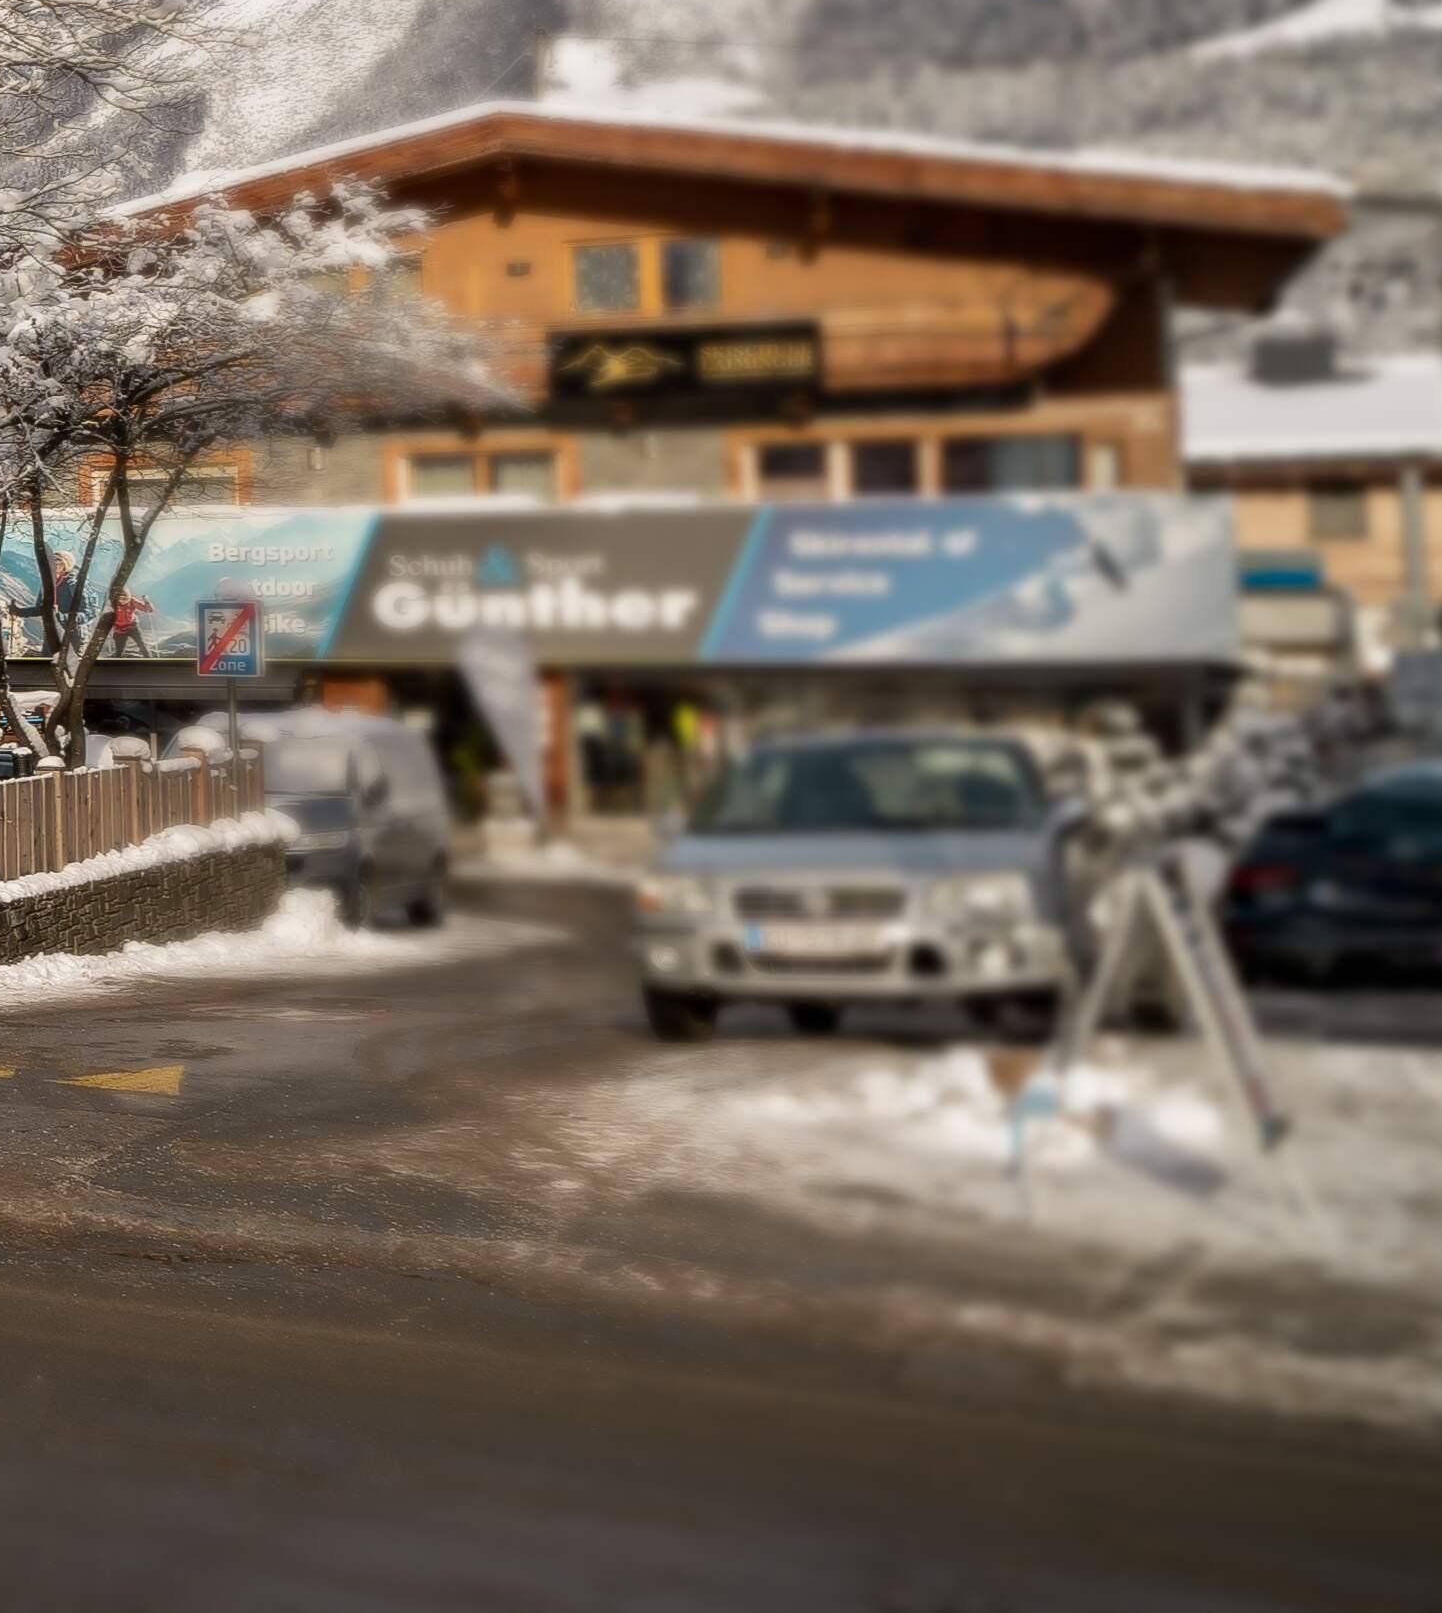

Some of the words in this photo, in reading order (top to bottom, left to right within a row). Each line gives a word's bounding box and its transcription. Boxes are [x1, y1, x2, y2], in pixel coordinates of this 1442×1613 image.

[207, 542, 336, 567] Bergsport
[389, 553, 473, 577] Schuh
[248, 577, 320, 598] tdoor
[373, 576, 698, 629] Günther
[230, 638, 247, 654] 20
[209, 660, 247, 672] Zone
